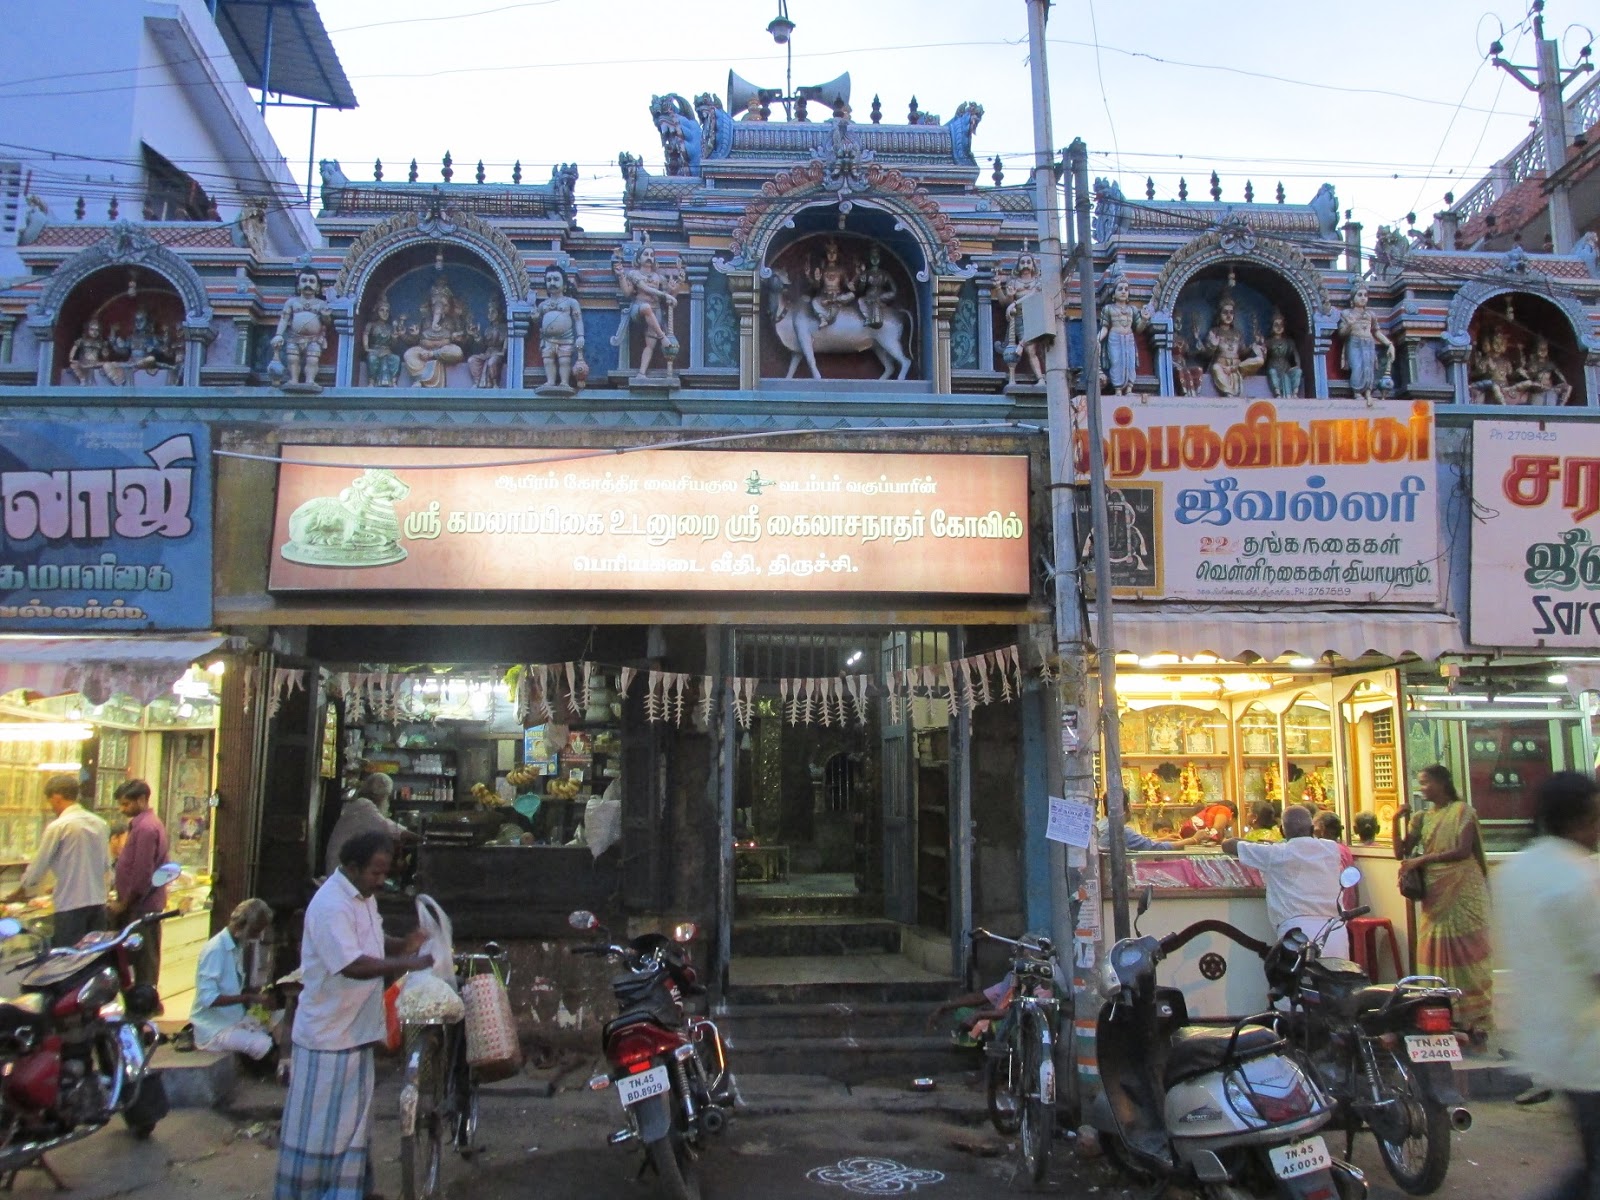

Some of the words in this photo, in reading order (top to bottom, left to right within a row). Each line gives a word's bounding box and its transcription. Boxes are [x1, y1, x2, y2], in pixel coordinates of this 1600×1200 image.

[449, 504, 605, 536] கமலாம்பிகை
[609, 508, 719, 547] உடனுறை
[767, 508, 925, 544] கைலாசநாதர்
[930, 508, 1024, 540] கோவில்
[768, 552, 859, 577] திருச்சி.
[1414, 1038, 1451, 1048] TN.48
[628, 1073, 655, 1089] TN.45
[627, 1083, 663, 1102] BD.8929
[1285, 1144, 1314, 1160] TN.45
